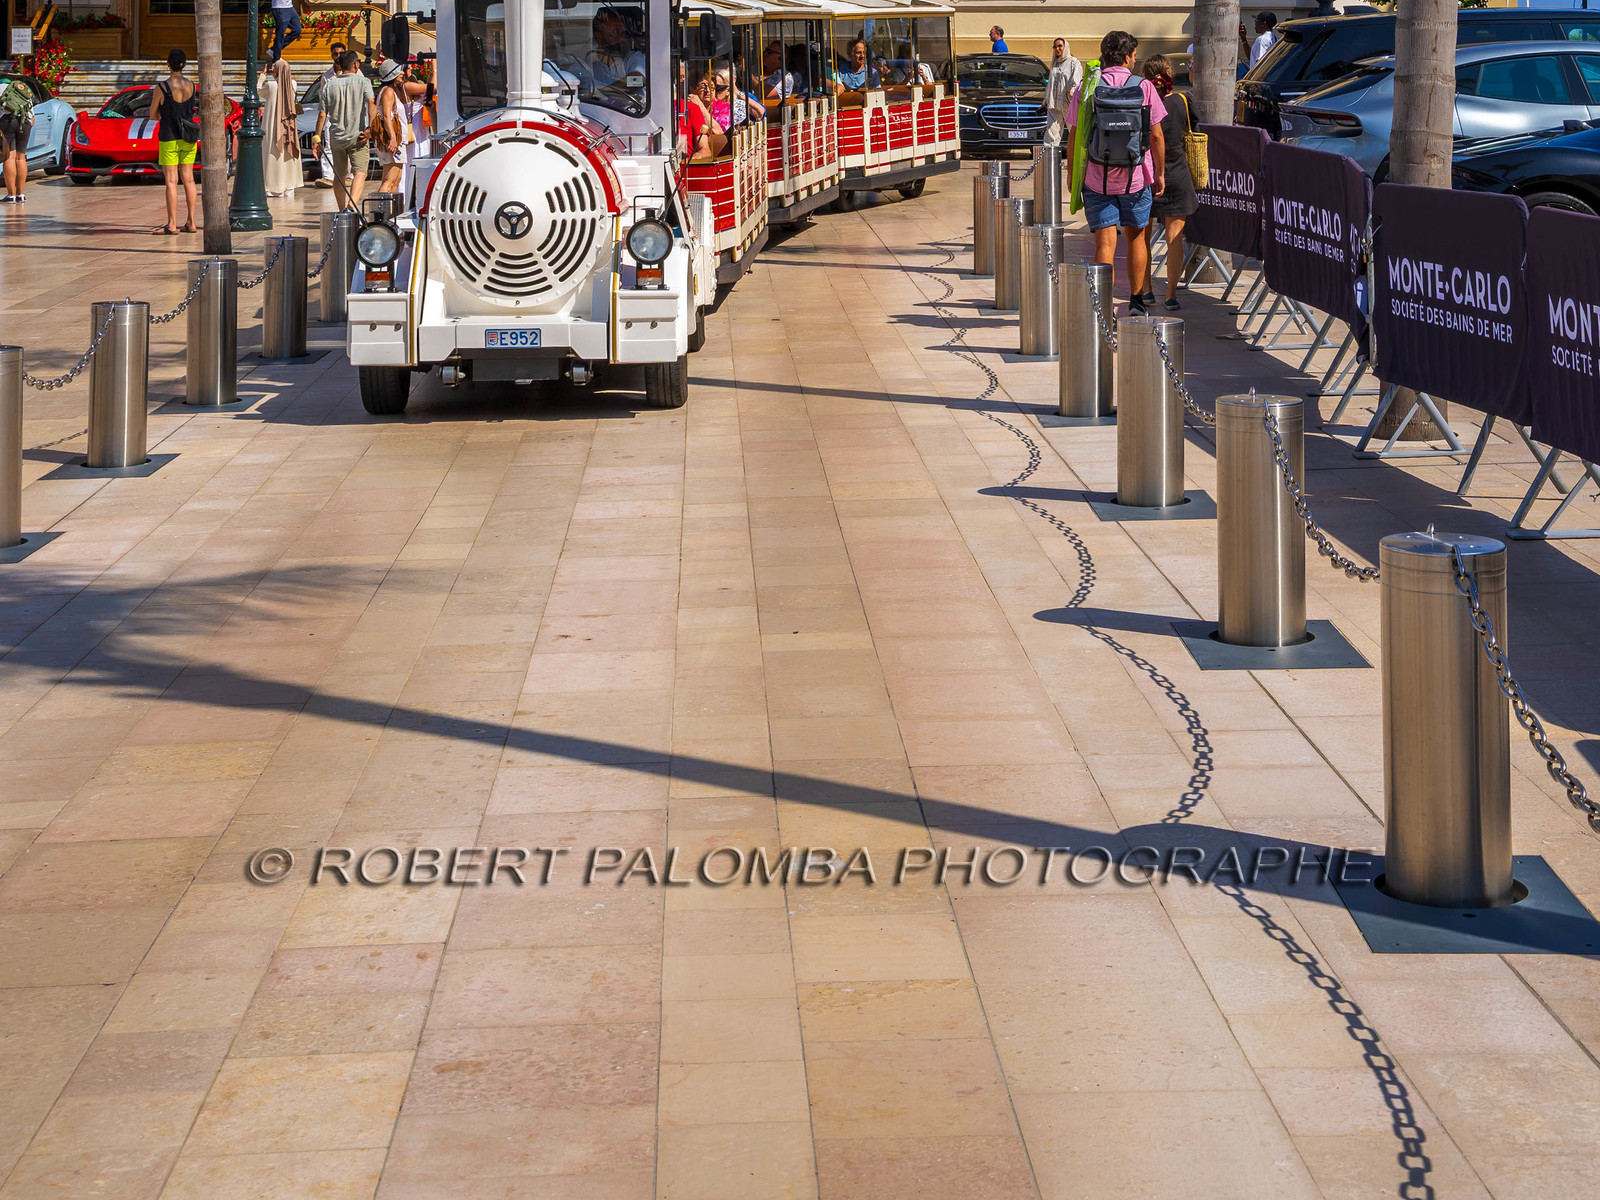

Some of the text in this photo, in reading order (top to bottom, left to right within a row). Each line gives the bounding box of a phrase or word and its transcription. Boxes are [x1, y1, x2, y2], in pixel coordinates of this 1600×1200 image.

[1211, 194, 1222, 207] DES
[1222, 197, 1238, 210] BAINS
[1239, 199, 1246, 211] DE
[1246, 201, 1257, 213] MER
[1293, 234, 1306, 250] DES
[1324, 243, 1332, 259] DE
[1332, 246, 1345, 263] MER
[1391, 298, 1513, 344] SOCIÉTÉ DES BAINS DE MER
[499, 331, 539, 346] E952
[1551, 344, 1593, 377] SOCIÉTÉ
